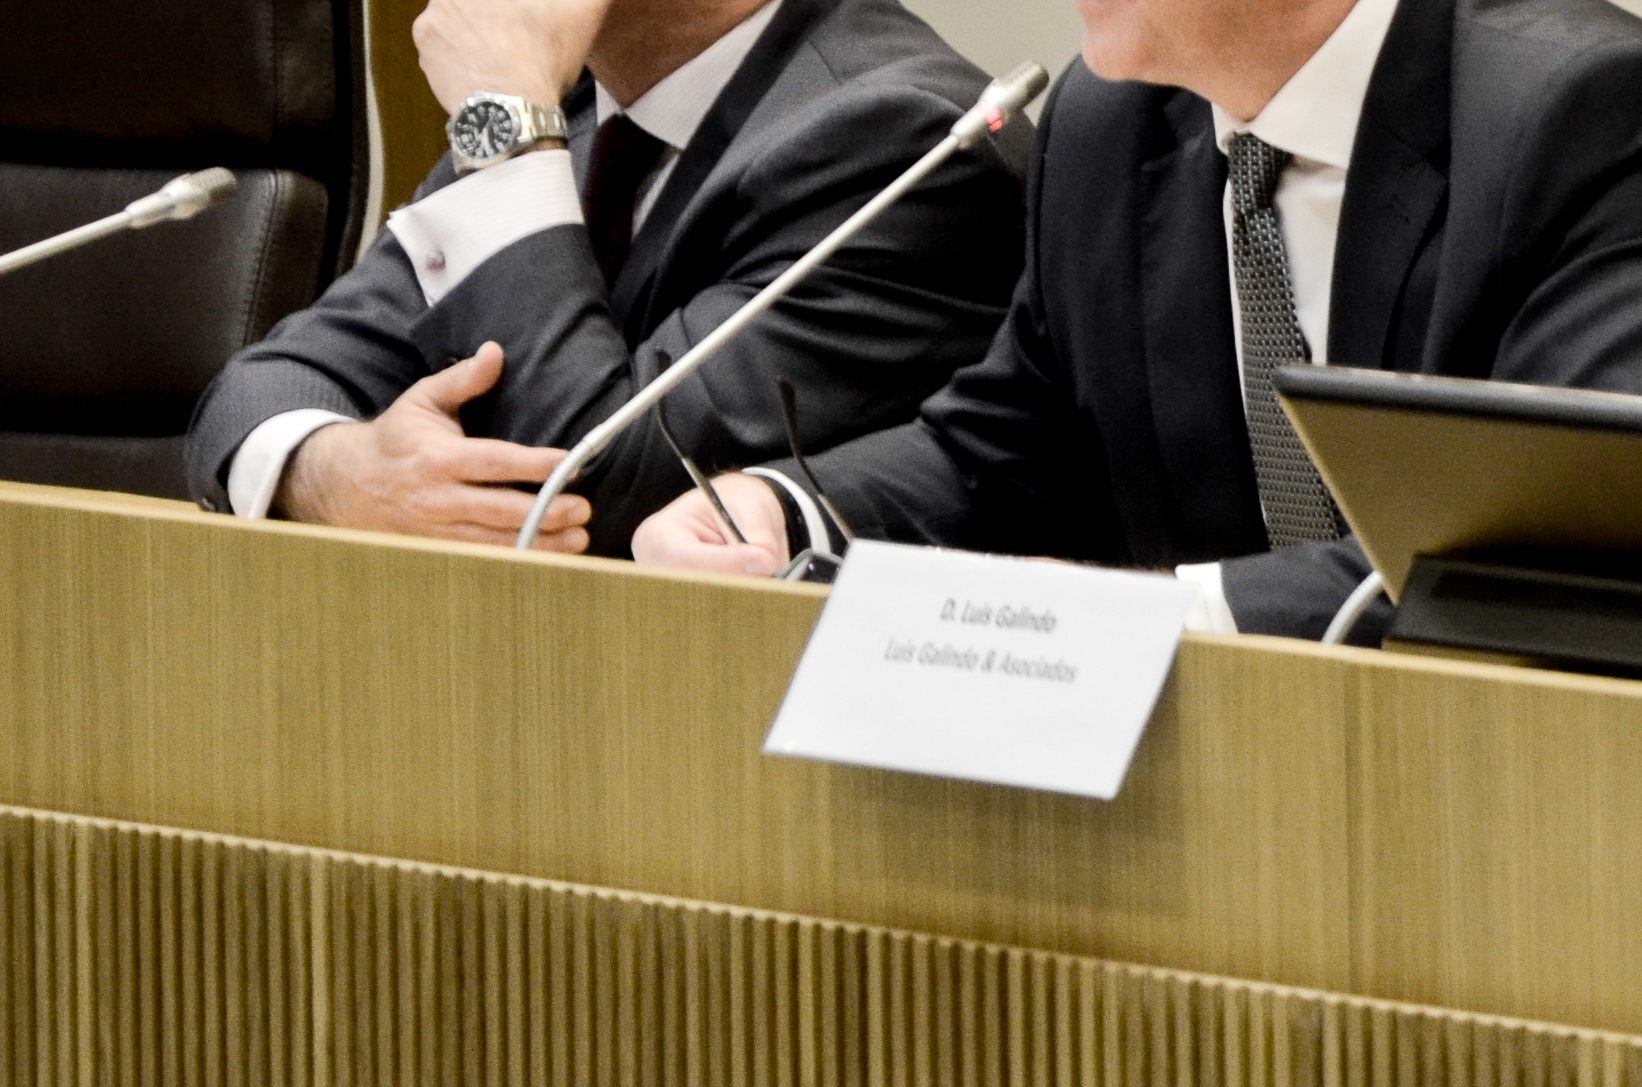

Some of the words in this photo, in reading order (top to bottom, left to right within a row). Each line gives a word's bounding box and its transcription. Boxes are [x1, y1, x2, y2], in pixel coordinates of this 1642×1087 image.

[940, 596, 957, 621] D.
[961, 600, 993, 625] Luis
[995, 603, 1057, 633] Galindo
[884, 637, 917, 662] Luis
[918, 640, 979, 671] Galindo
[980, 648, 997, 673] &
[998, 651, 1078, 684] Asociados
